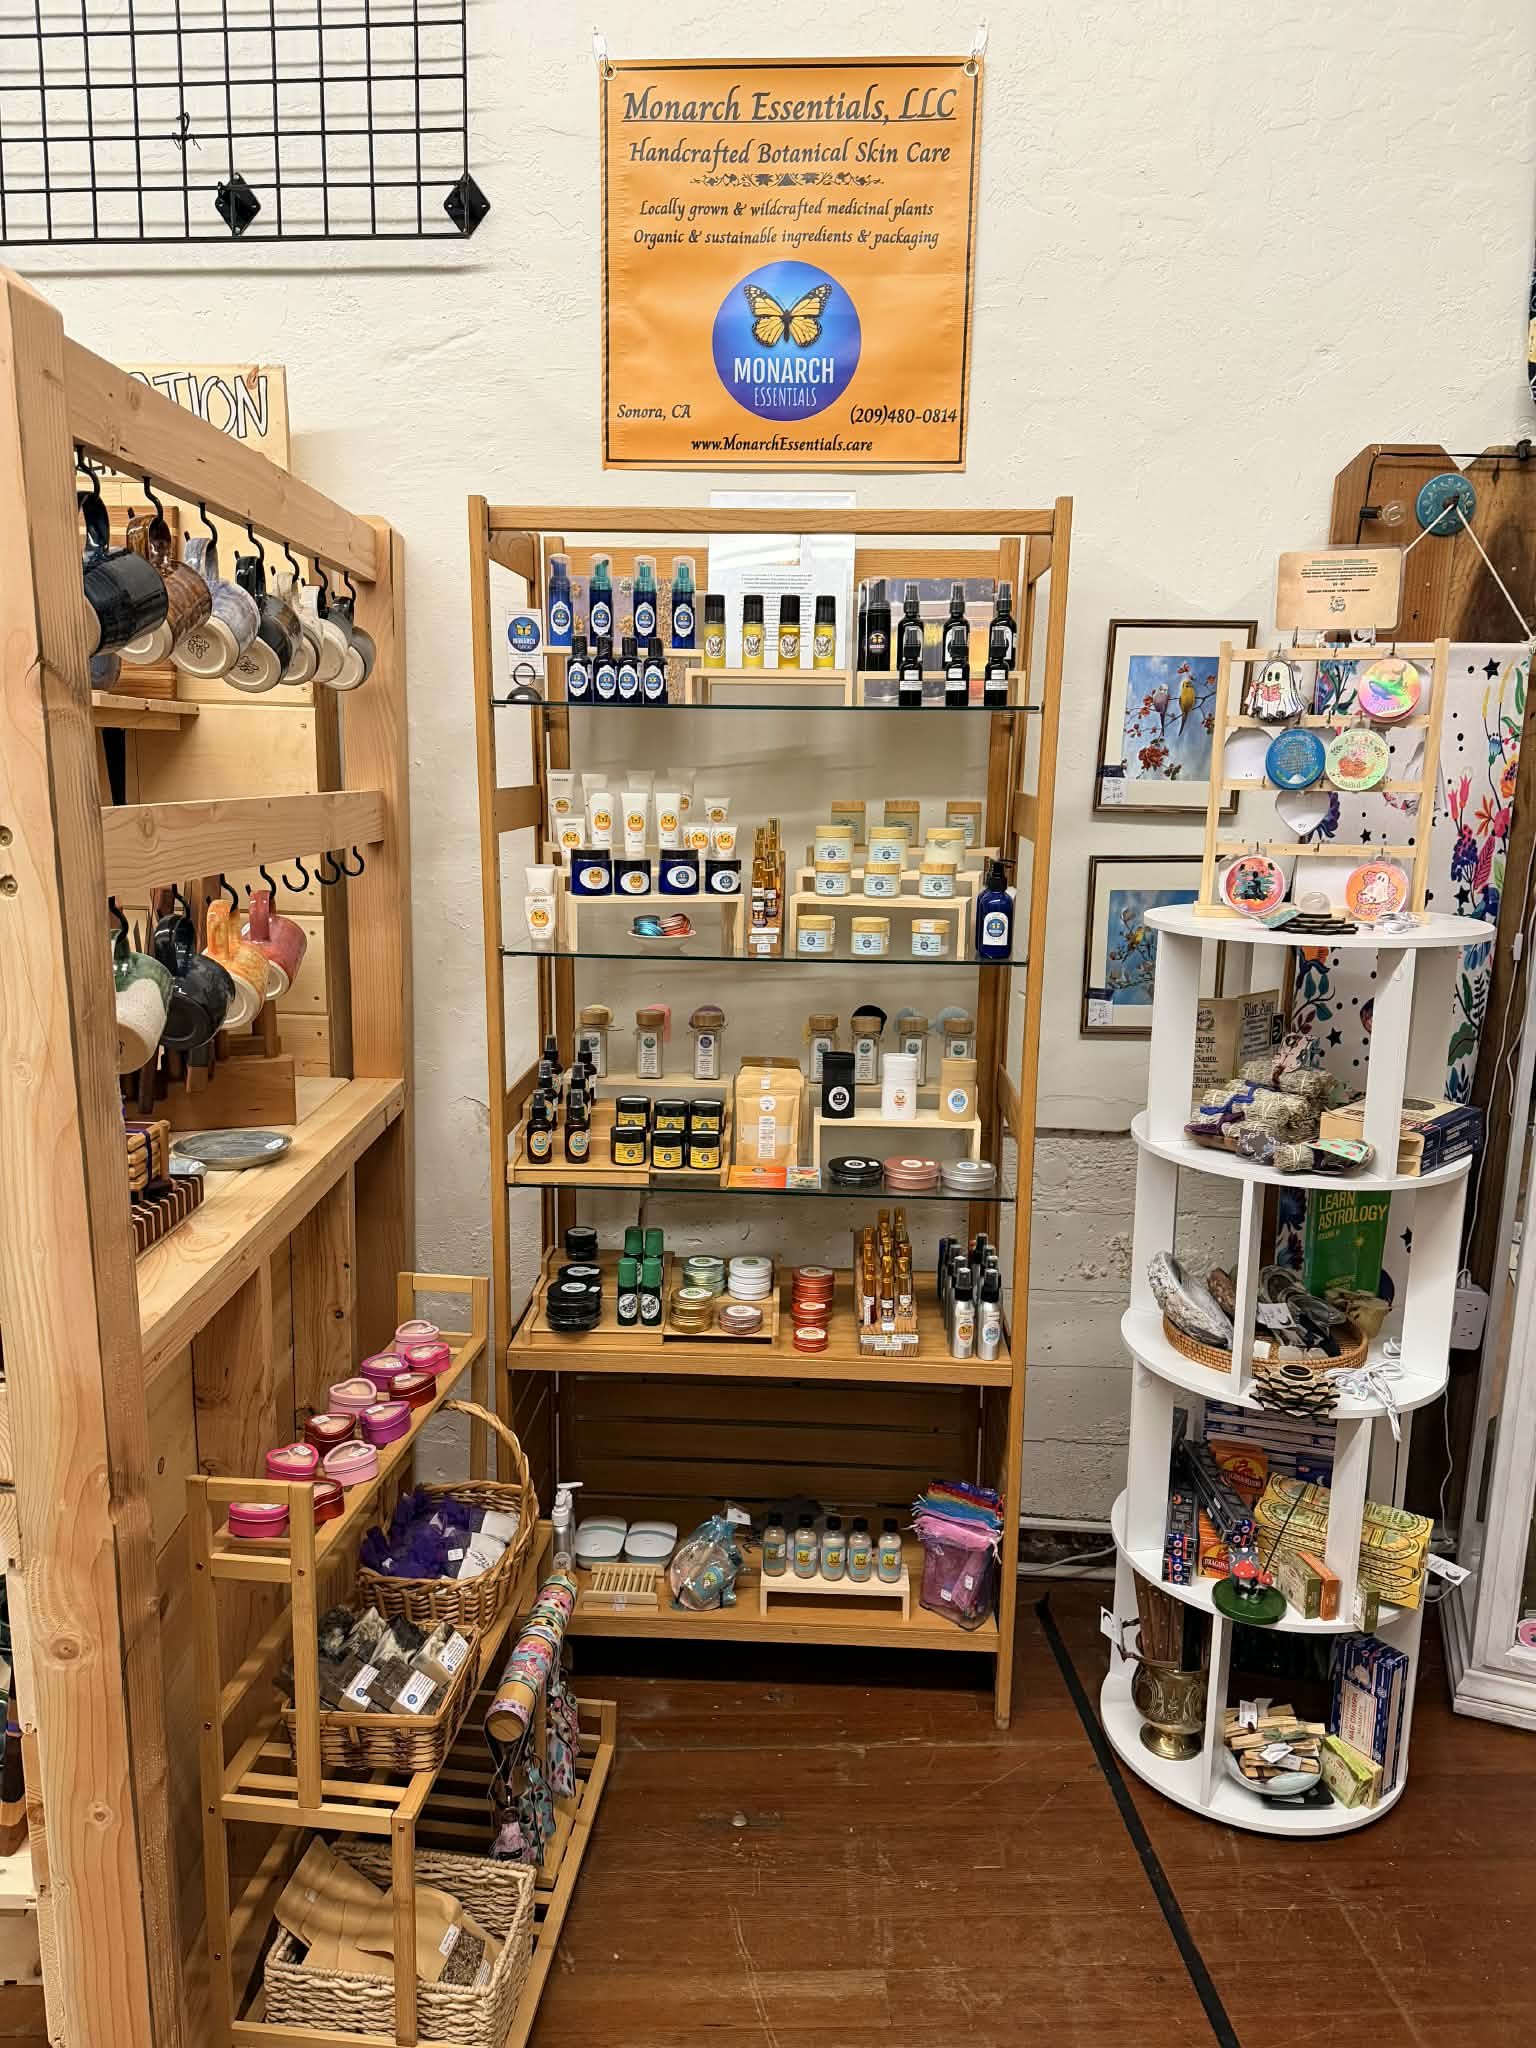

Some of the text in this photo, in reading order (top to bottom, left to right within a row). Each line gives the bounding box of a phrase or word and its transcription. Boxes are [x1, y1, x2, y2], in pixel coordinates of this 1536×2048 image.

[623, 84, 957, 125] Monarch Essentials, LLC
[629, 137, 951, 173] Handcrafted Botanical Skin Care
[640, 198, 934, 222] Locally grown & wildcrafted medicinal plants
[633, 226, 939, 250] Organic & sustainable ingredients & packaging
[733, 357, 835, 385] MONARCH
[128, 371, 268, 439] TION
[754, 387, 817, 407] ESSENTIALS
[616, 404, 692, 421] Sonora, CA
[850, 404, 958, 427] (209)480-0814
[691, 432, 873, 452] www.MonarchEssentials.care
[1320, 1191, 1356, 1212] LEARN
[1318, 1205, 1388, 1231] ASTROLOGY
